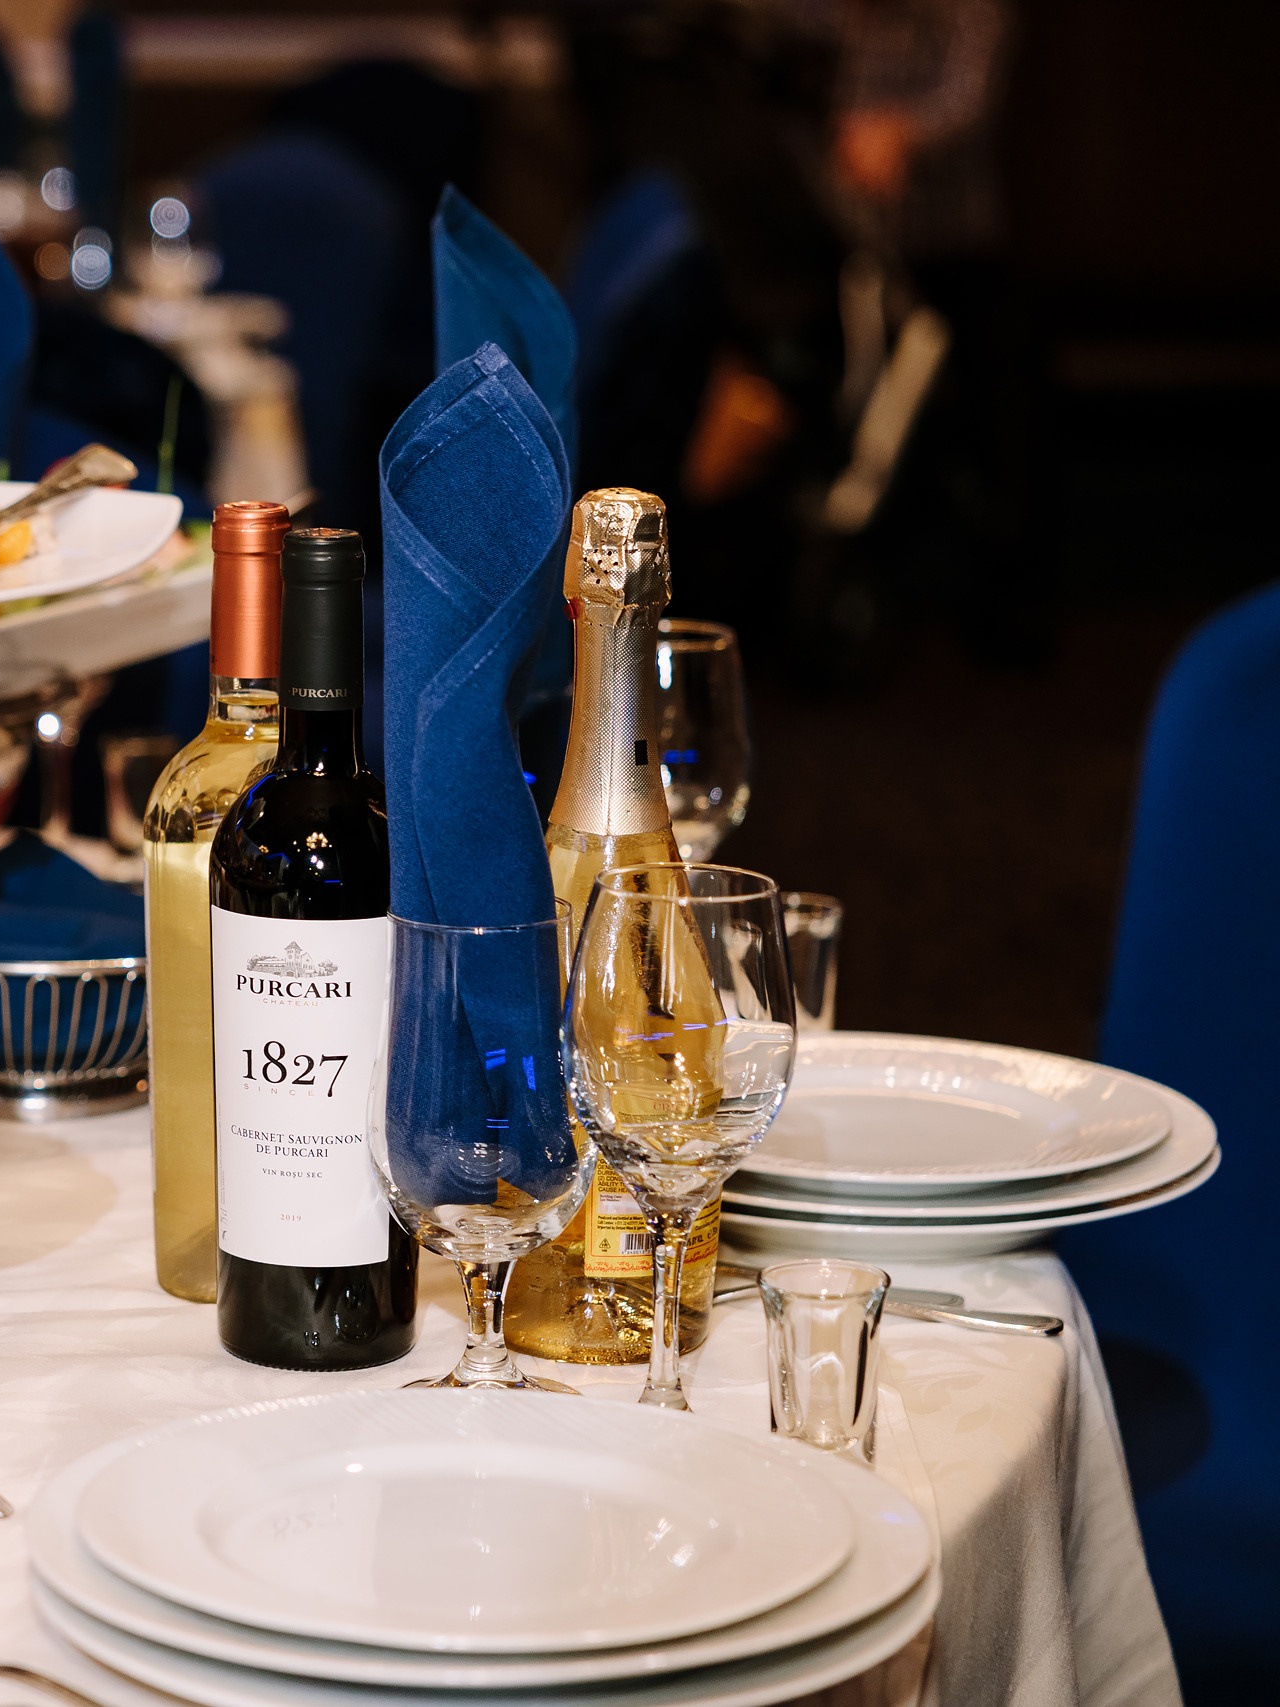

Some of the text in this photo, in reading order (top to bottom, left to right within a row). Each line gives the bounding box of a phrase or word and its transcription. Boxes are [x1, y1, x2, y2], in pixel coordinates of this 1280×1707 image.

[291, 687, 347, 698] PURCARI
[236, 974, 352, 998] PURCARI
[262, 998, 319, 1007] CHATEAU
[242, 1041, 349, 1097] 1827
[243, 1083, 315, 1097] SINCE
[231, 1124, 363, 1145] CABERNET SAUVIGNON
[256, 1143, 329, 1157] DE PURCARI
[262, 1168, 277, 1176] VIN
[306, 1171, 323, 1179] SEC
[280, 1213, 302, 1222] 2019
